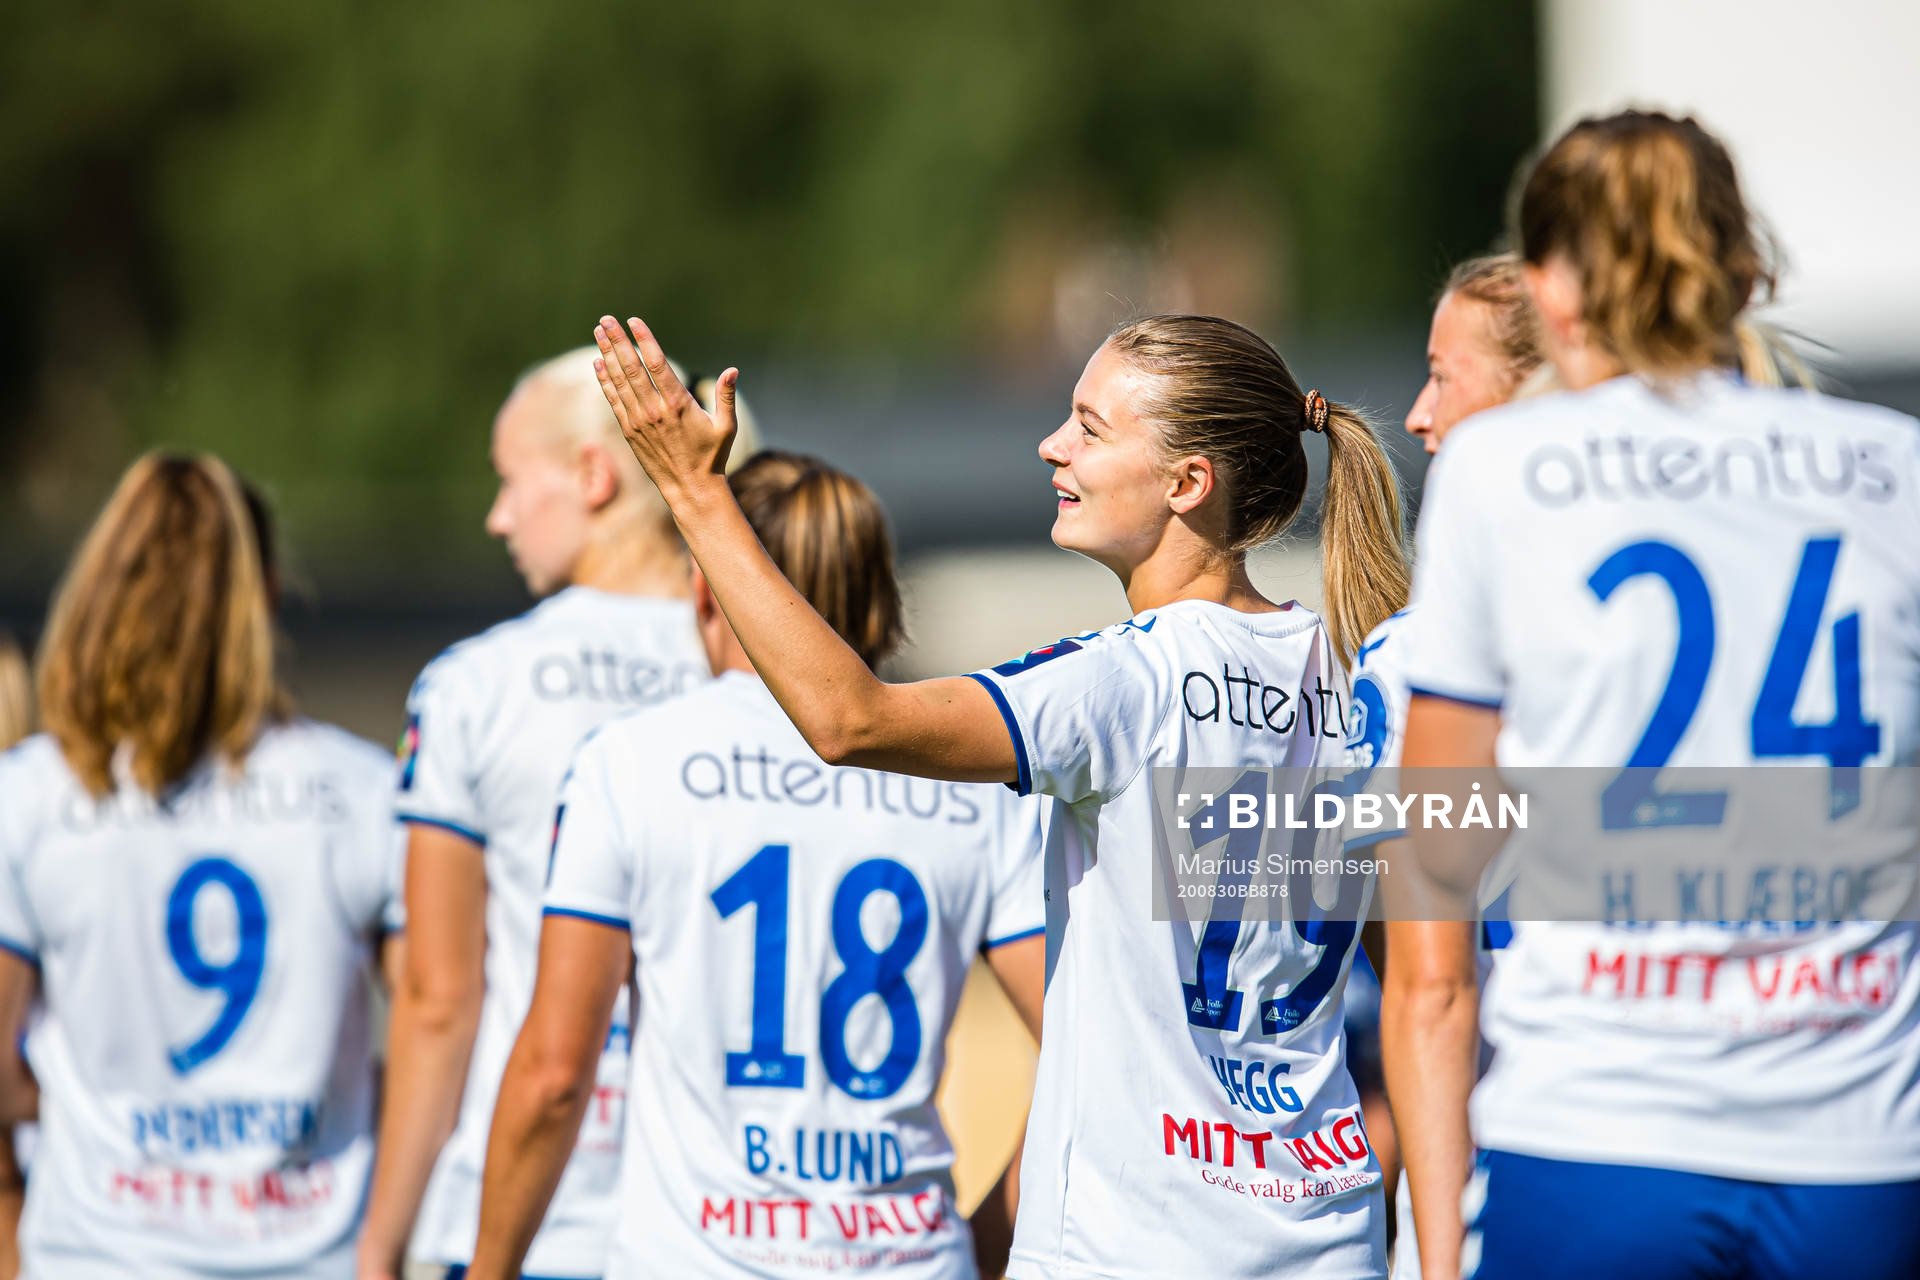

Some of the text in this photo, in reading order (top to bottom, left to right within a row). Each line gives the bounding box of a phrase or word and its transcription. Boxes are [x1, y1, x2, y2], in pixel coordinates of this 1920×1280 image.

[1523, 428, 1898, 507] attentus
[1588, 536, 1881, 829] 24
[166, 857, 267, 1076] 9
[709, 845, 929, 1100] 18
[1583, 951, 1725, 1002] MITT
[1209, 1055, 1304, 1114] HEGG
[1163, 1113, 1272, 1169] MITT
[1202, 1169, 1245, 1194] Gode
[1248, 1179, 1295, 1203] valg
[1301, 1178, 1335, 1198] kan
[700, 1198, 811, 1239] MITT
